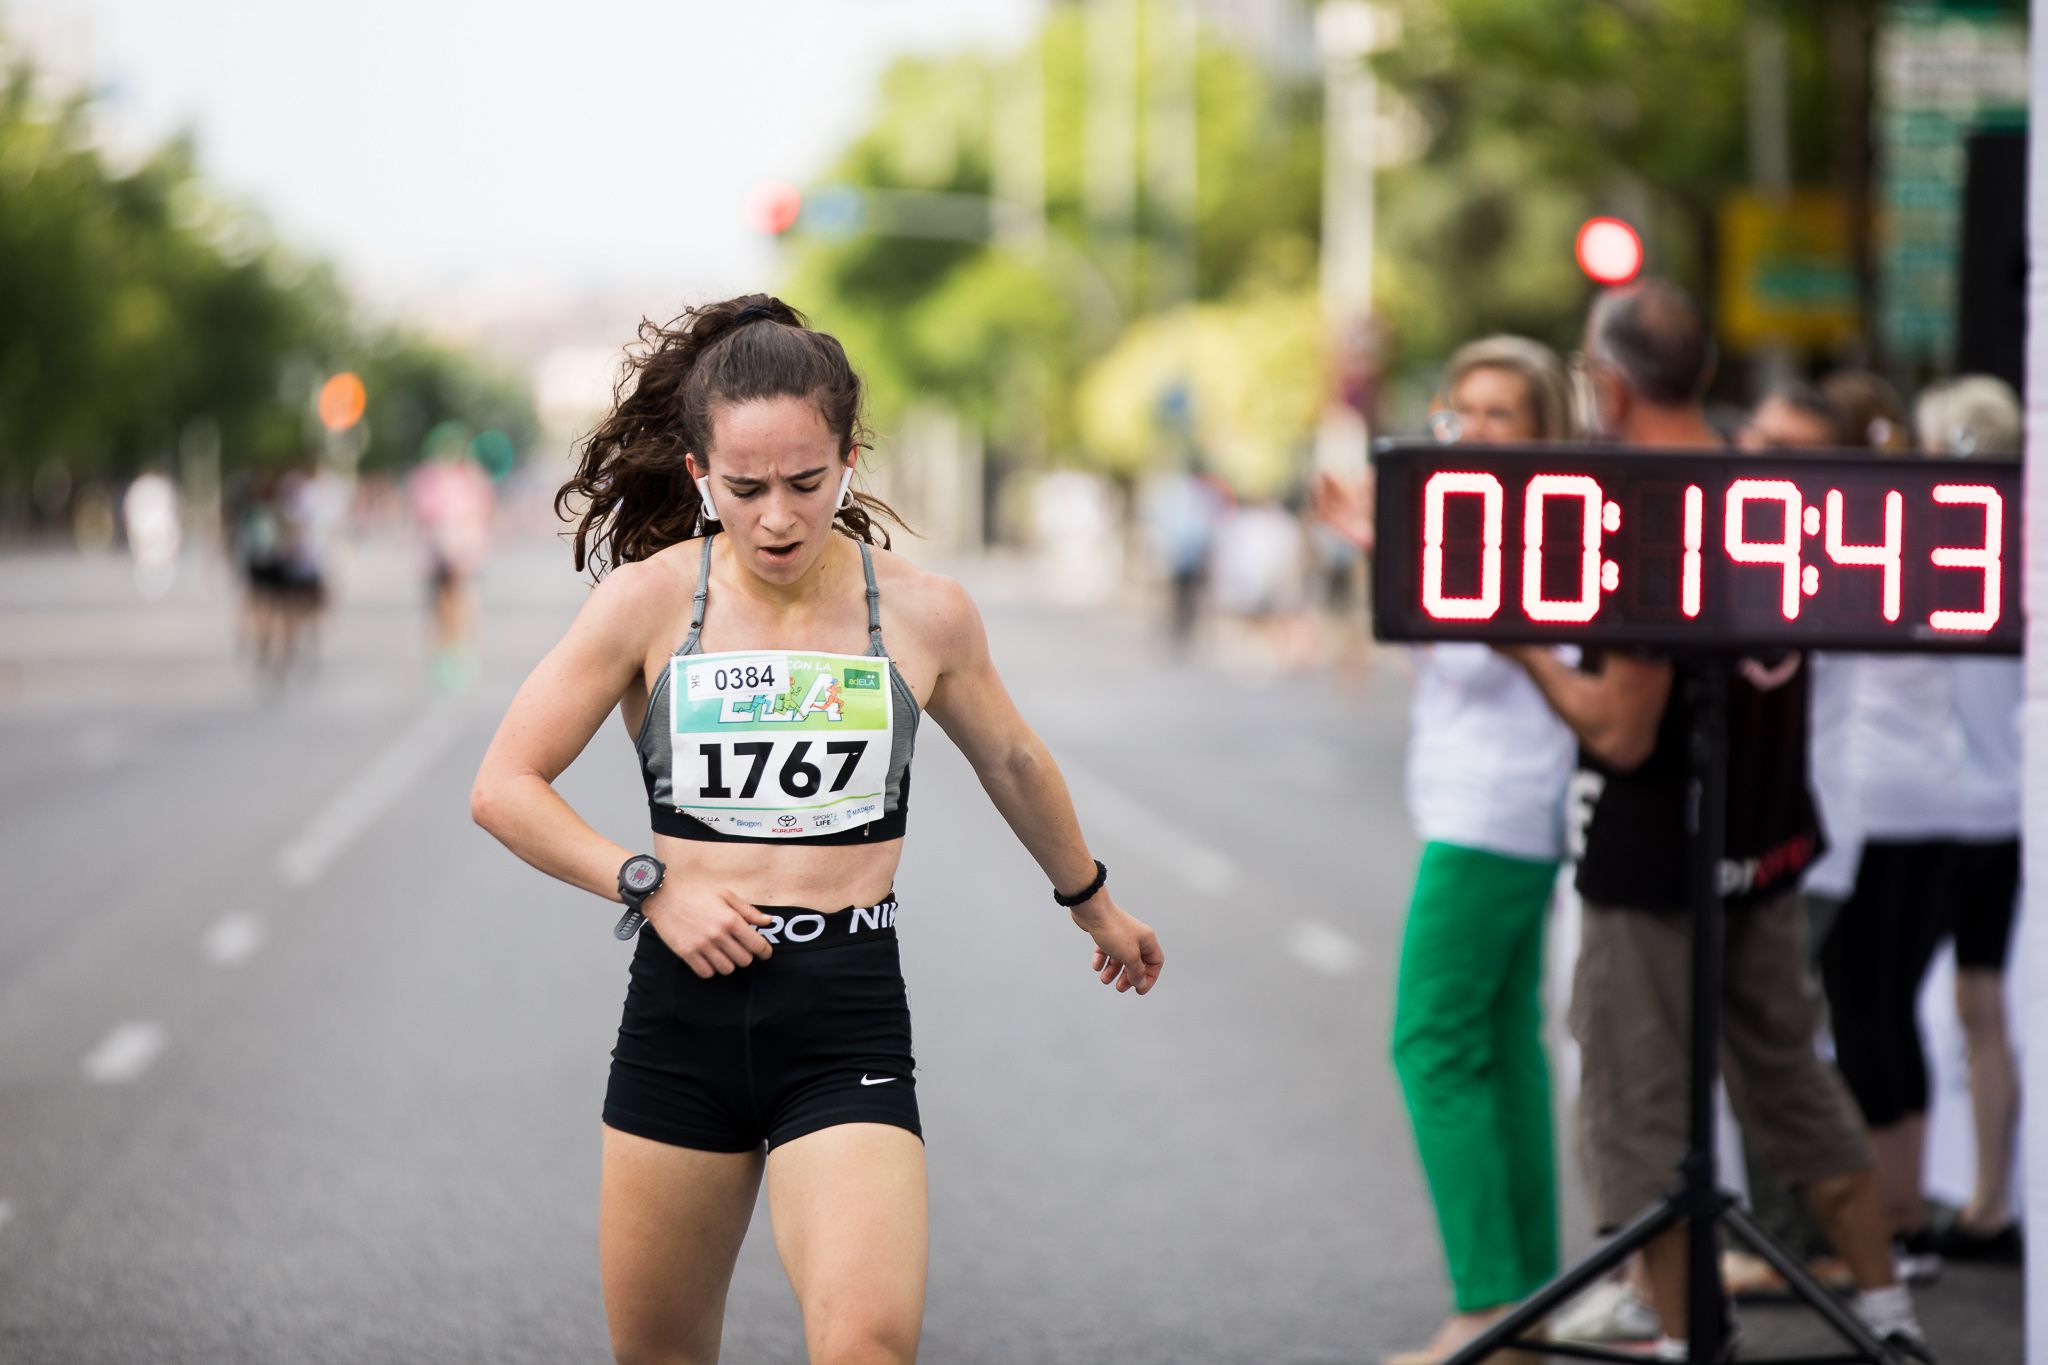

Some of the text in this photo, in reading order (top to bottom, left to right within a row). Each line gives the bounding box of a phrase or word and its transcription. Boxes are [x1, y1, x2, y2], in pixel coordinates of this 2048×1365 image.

[1421, 470, 2004, 633] 00:19:43
[816, 661, 832, 672] LA
[690, 674, 702, 689] 5K
[714, 664, 776, 691] 0384
[699, 740, 869, 799] 1767
[736, 819, 762, 829] Biogen
[815, 819, 832, 827] LIFE
[751, 914, 826, 944] RO
